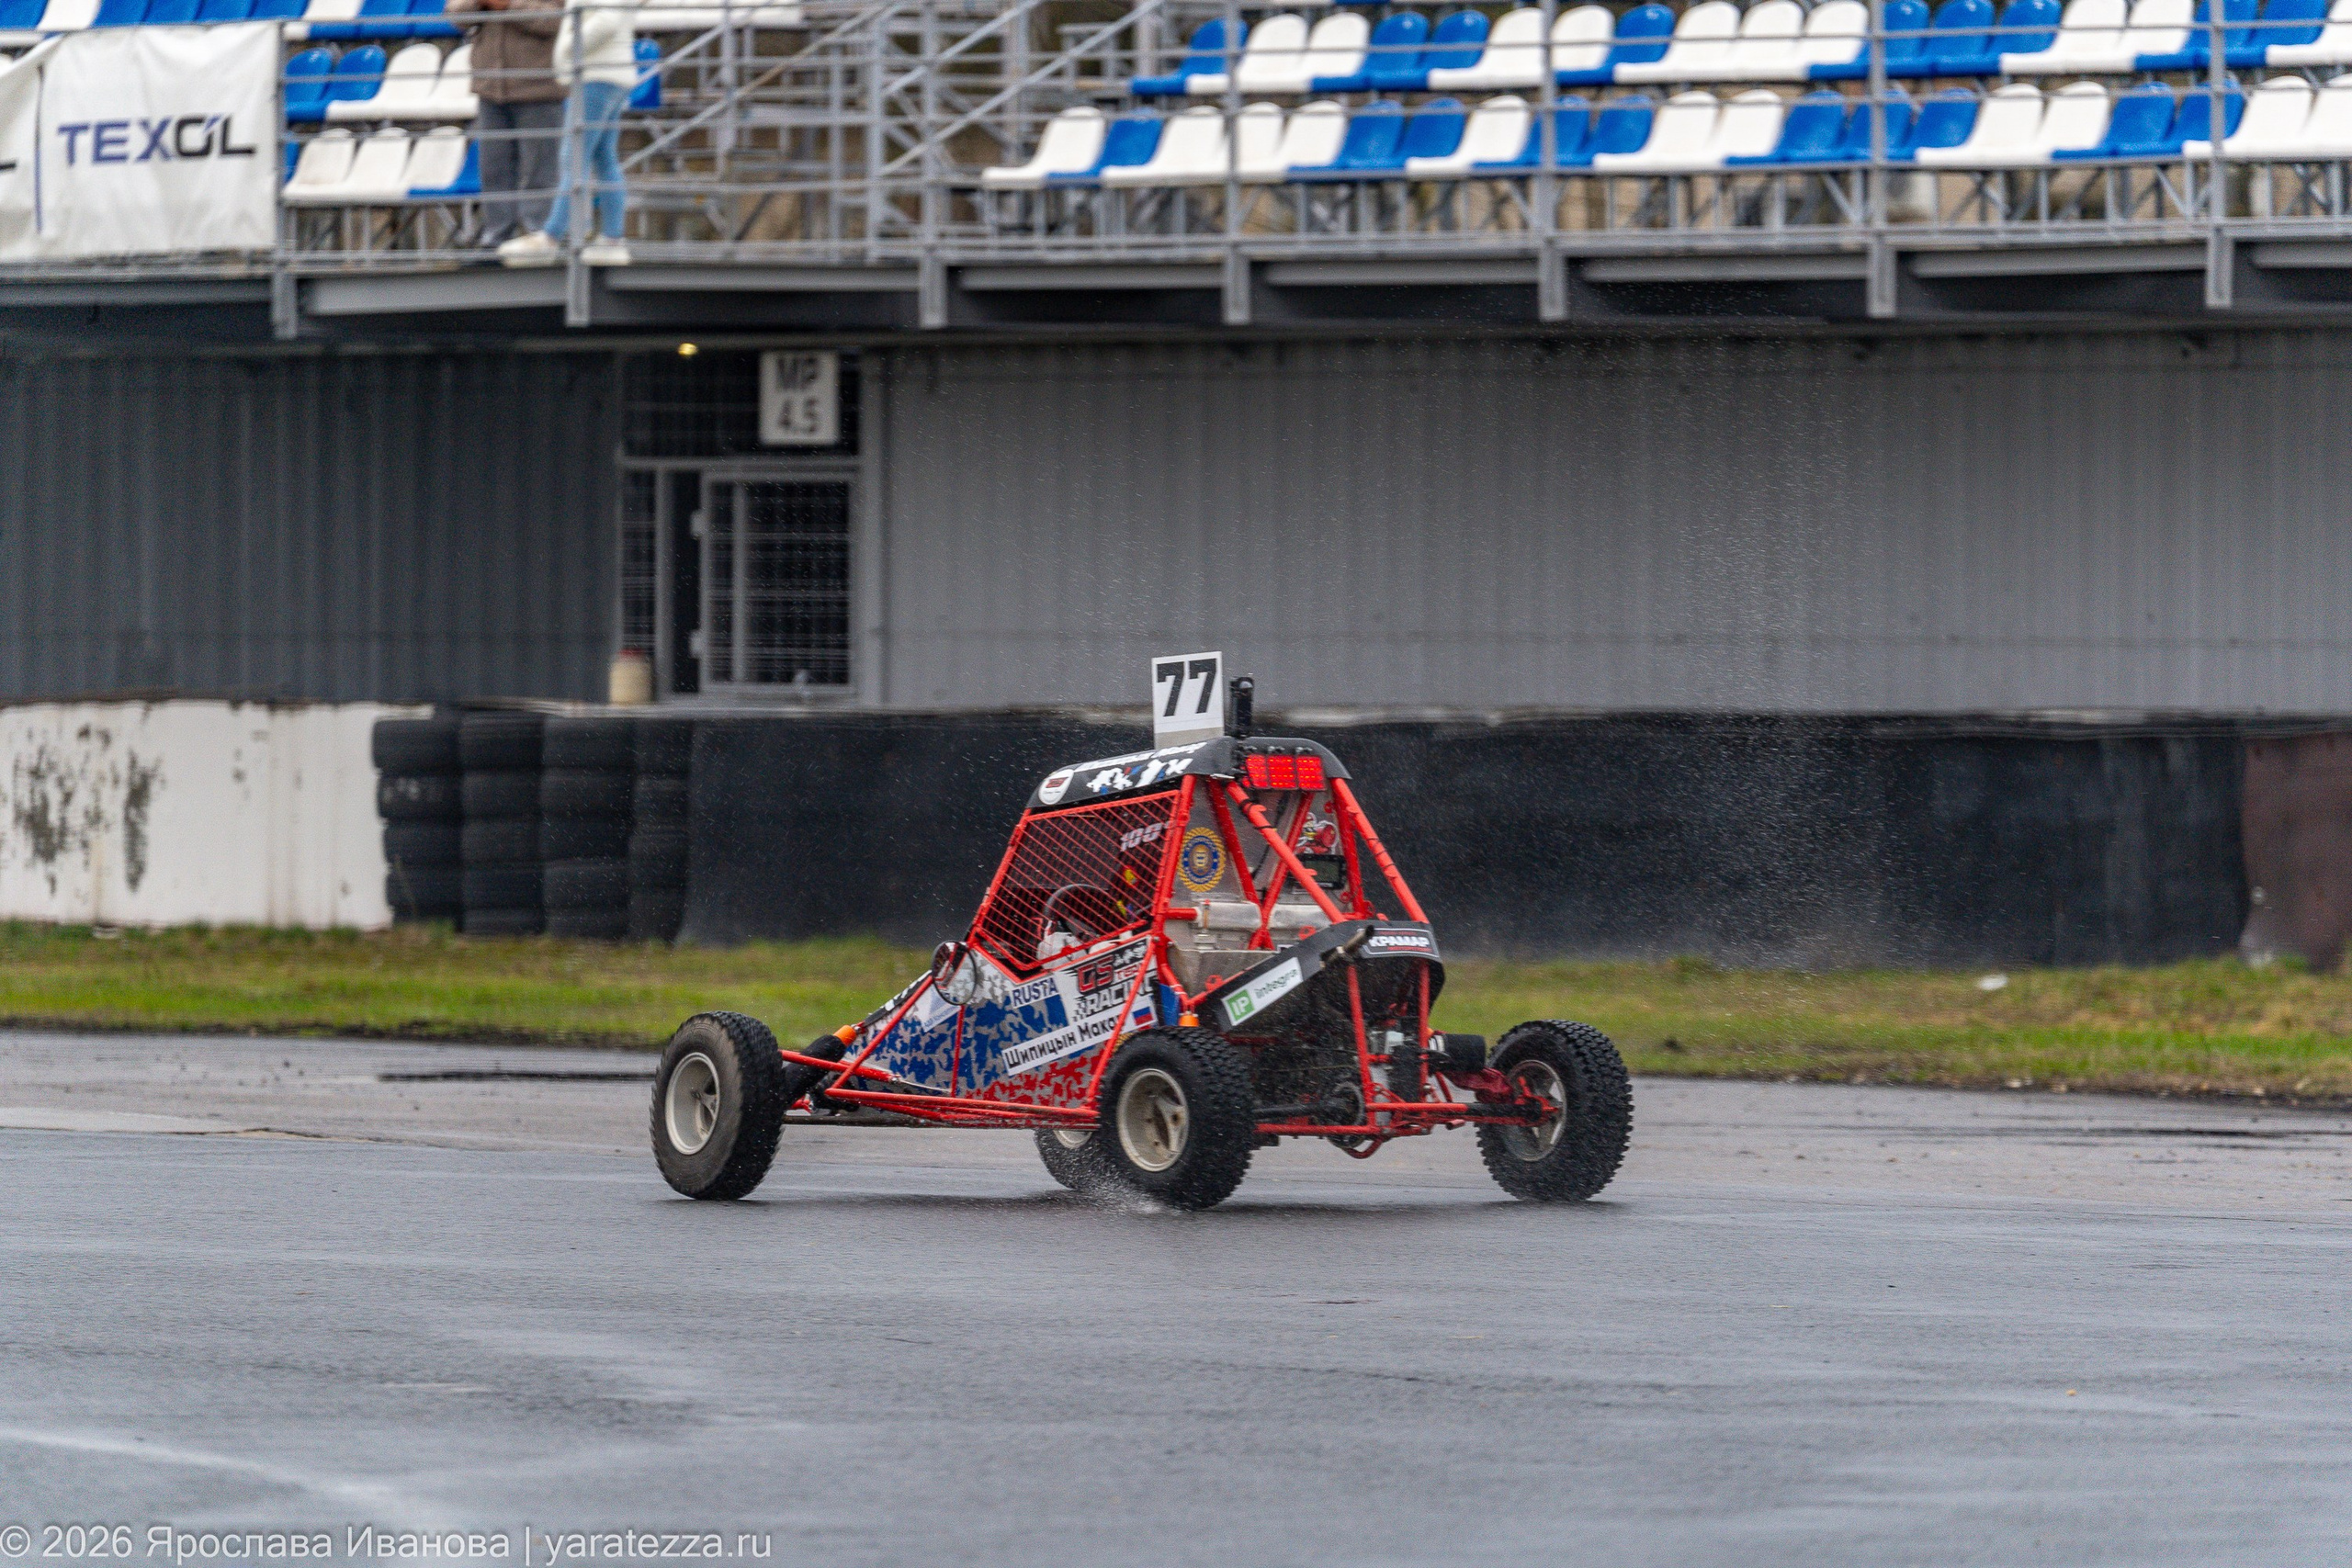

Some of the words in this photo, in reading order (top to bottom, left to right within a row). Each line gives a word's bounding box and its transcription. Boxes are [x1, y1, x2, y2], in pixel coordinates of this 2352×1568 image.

[57, 114, 256, 167] TEXOL
[1157, 658, 1217, 716] 77
[1012, 977, 1058, 1007] RUSTA
[1254, 968, 1298, 998] integra
[1232, 996, 1250, 1016] IP
[1005, 1031, 1077, 1068] Шипицын
[1078, 1010, 1122, 1042] Мака
